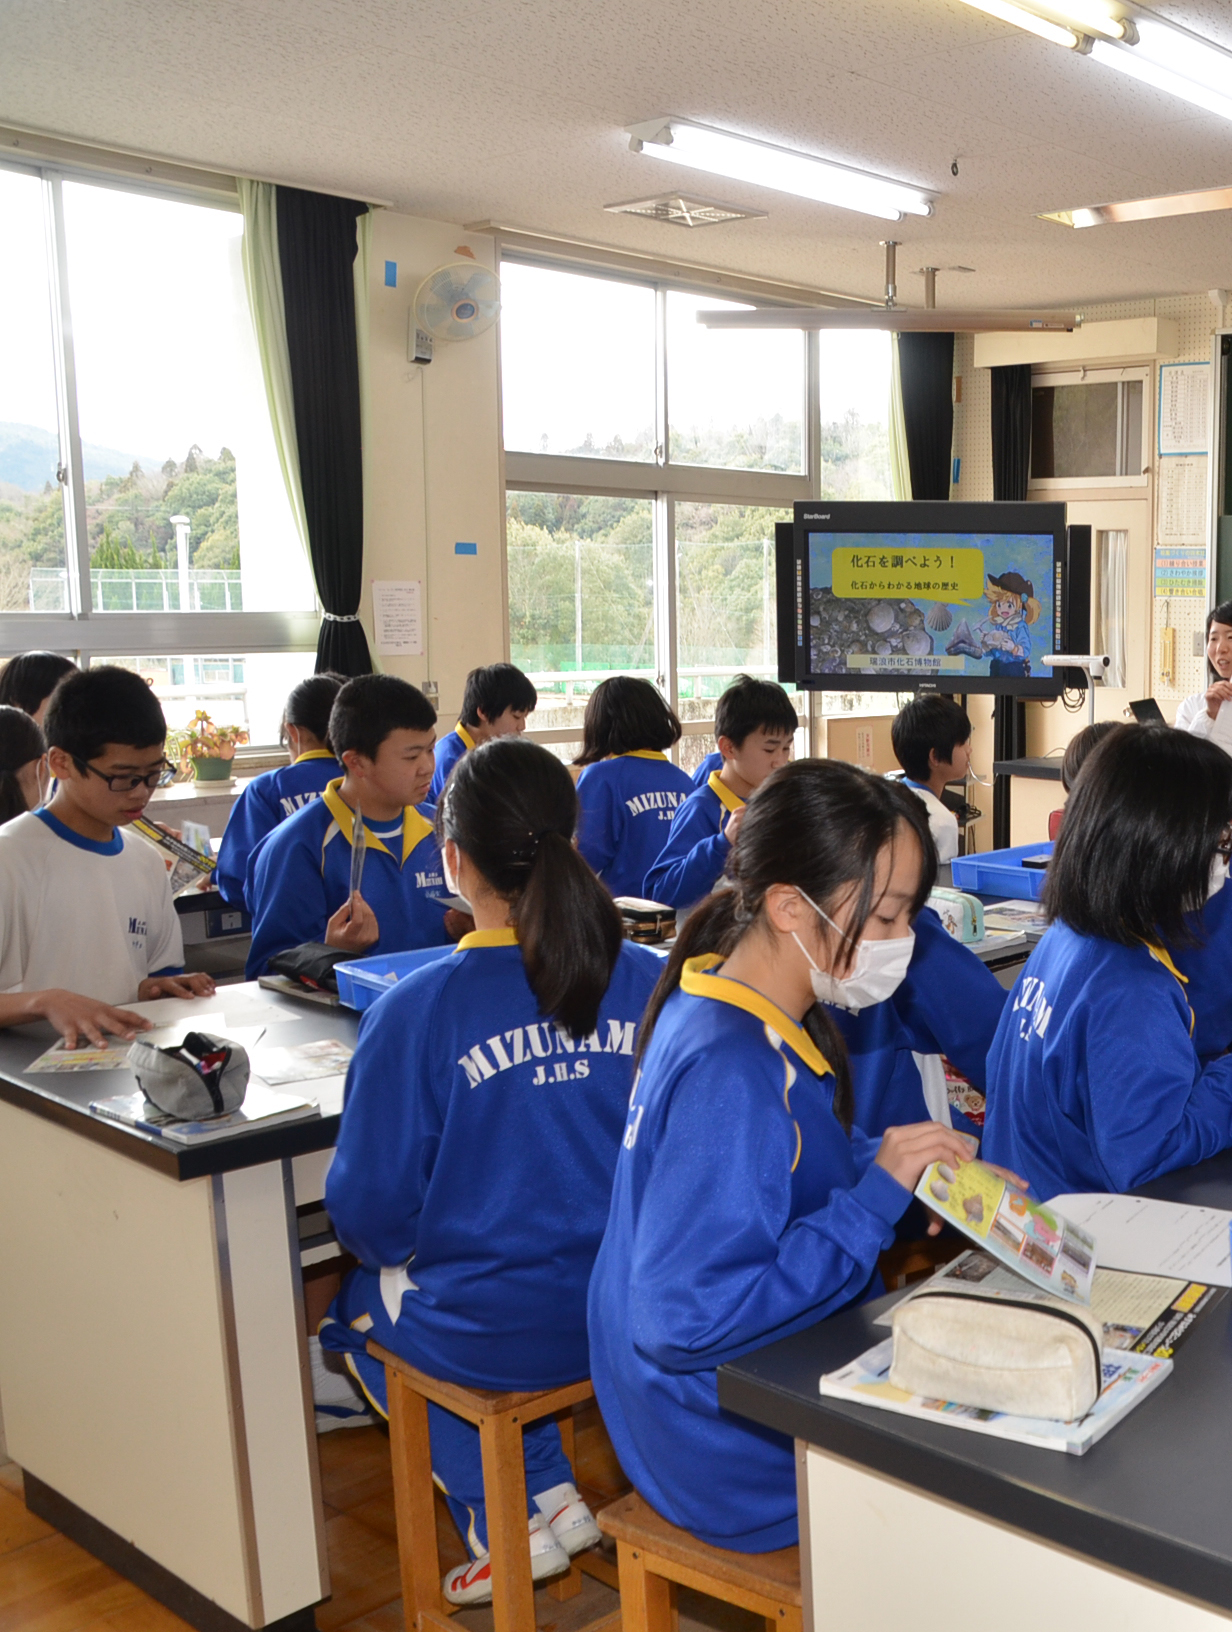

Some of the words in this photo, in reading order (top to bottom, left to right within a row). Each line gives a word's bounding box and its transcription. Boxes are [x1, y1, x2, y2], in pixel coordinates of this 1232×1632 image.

[851, 580, 959, 591] 化石からわかる地球の歴史
[869, 657, 942, 667] 瑞浪市化石博物館
[532, 1059, 590, 1086] J.H.S
